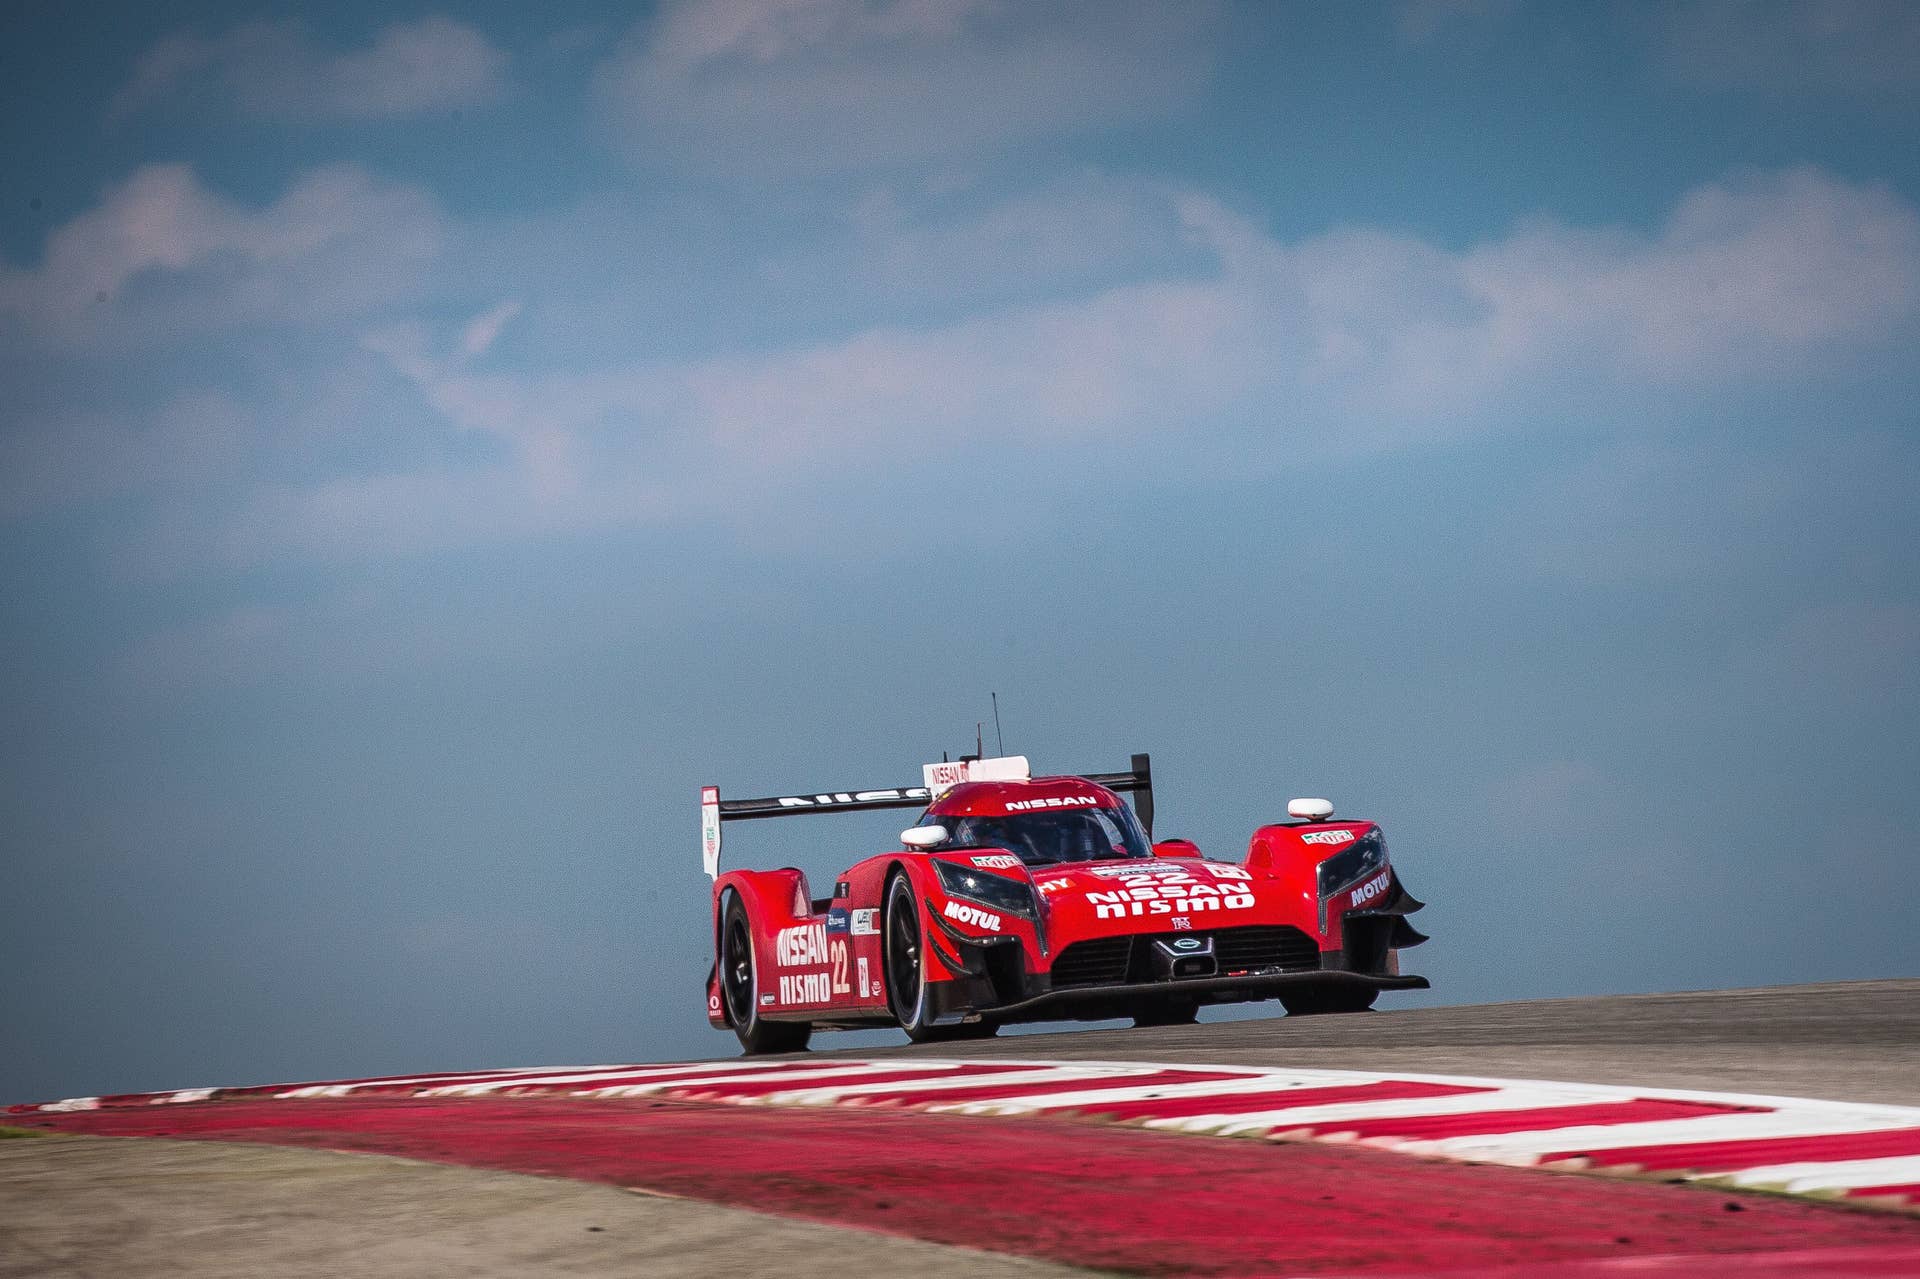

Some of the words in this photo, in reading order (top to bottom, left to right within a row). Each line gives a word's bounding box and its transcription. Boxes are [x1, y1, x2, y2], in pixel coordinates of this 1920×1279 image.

[932, 767, 960, 785] NISSAN
[1004, 796, 1097, 811] NISSAN
[1118, 872, 1198, 888] 22
[1085, 882, 1251, 904] NISSAN
[944, 901, 1001, 932] MOTUL
[776, 924, 829, 967] NISSAN
[830, 939, 850, 994] 22
